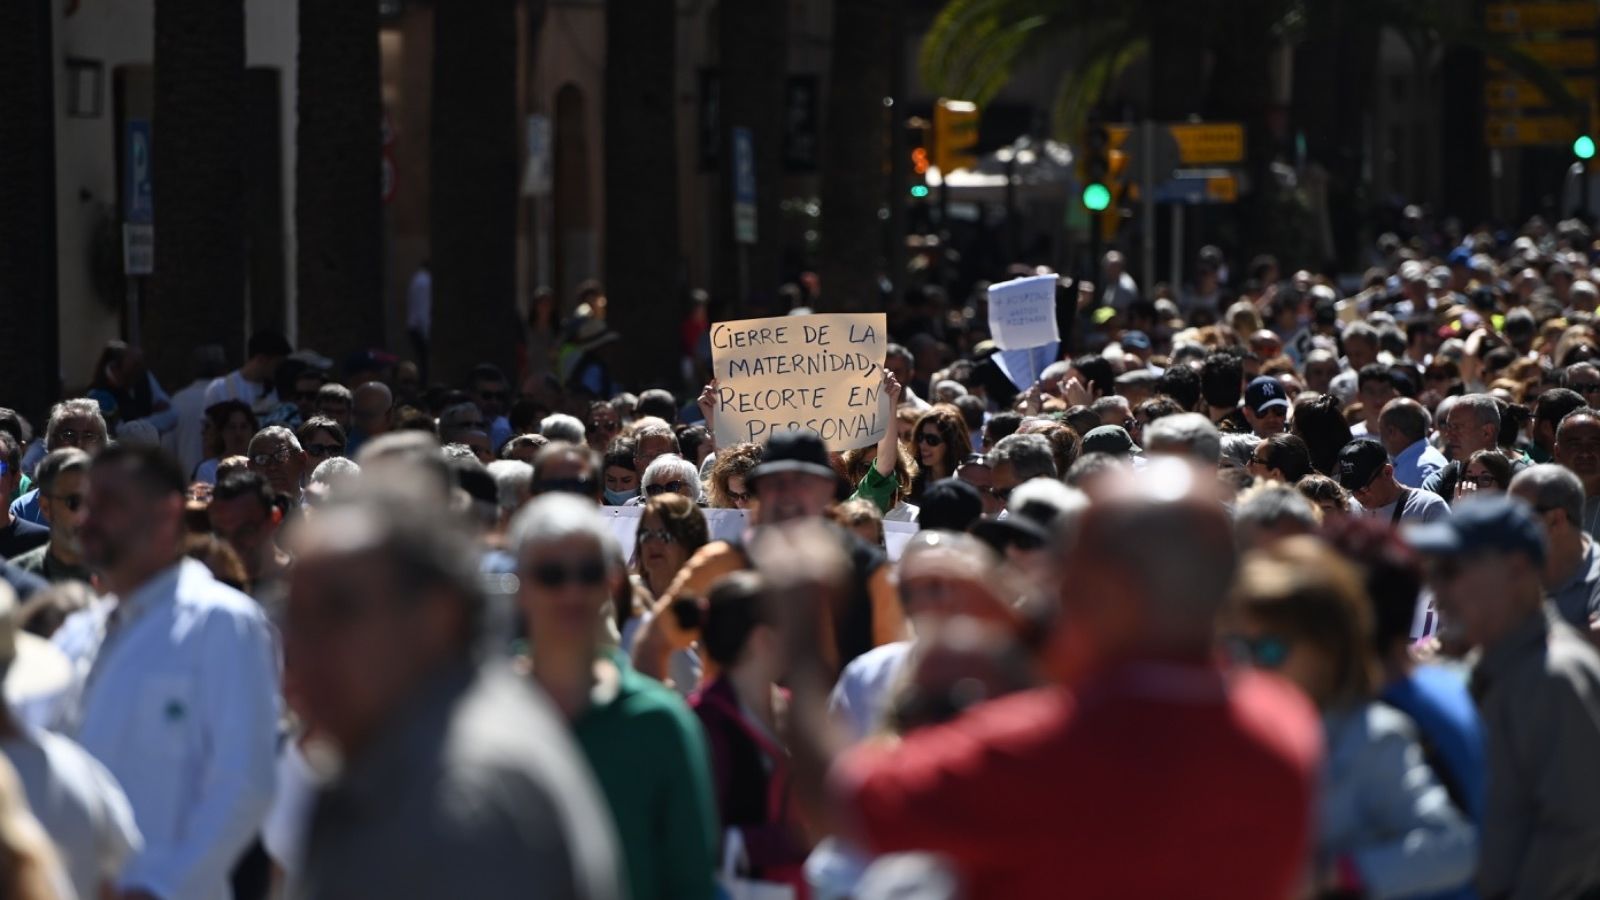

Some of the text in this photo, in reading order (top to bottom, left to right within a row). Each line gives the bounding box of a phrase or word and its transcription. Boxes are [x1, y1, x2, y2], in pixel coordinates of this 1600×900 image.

[713, 325, 876, 349] CIERRE DE LA
[729, 350, 877, 378] MATERNIDAD,
[718, 380, 882, 412] RECORTE EN
